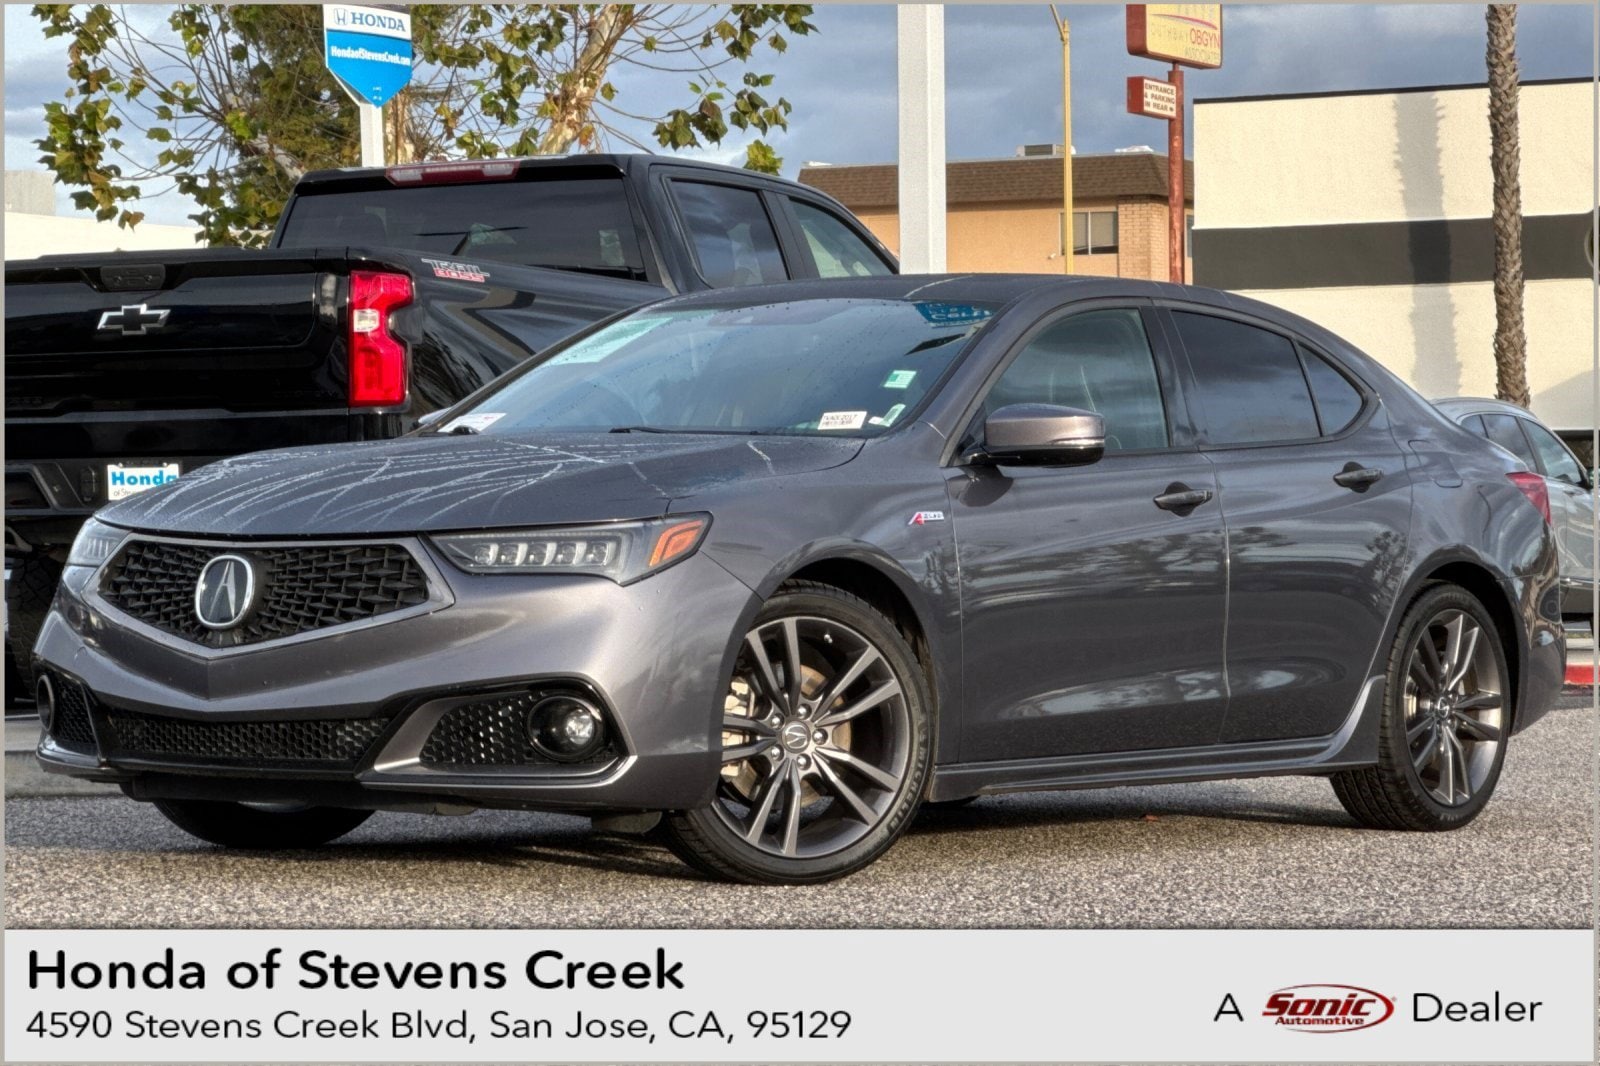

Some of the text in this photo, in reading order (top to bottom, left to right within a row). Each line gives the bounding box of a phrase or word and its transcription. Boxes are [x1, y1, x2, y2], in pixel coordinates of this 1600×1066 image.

[351, 12, 406, 32] HONDA
[1190, 28, 1220, 48] OBGYN
[1145, 83, 1174, 95] ENTRANCE
[1151, 93, 1175, 104] PARKING
[1153, 103, 1168, 111] REAR
[421, 258, 490, 277] TRAIL
[433, 268, 485, 283] BOSS
